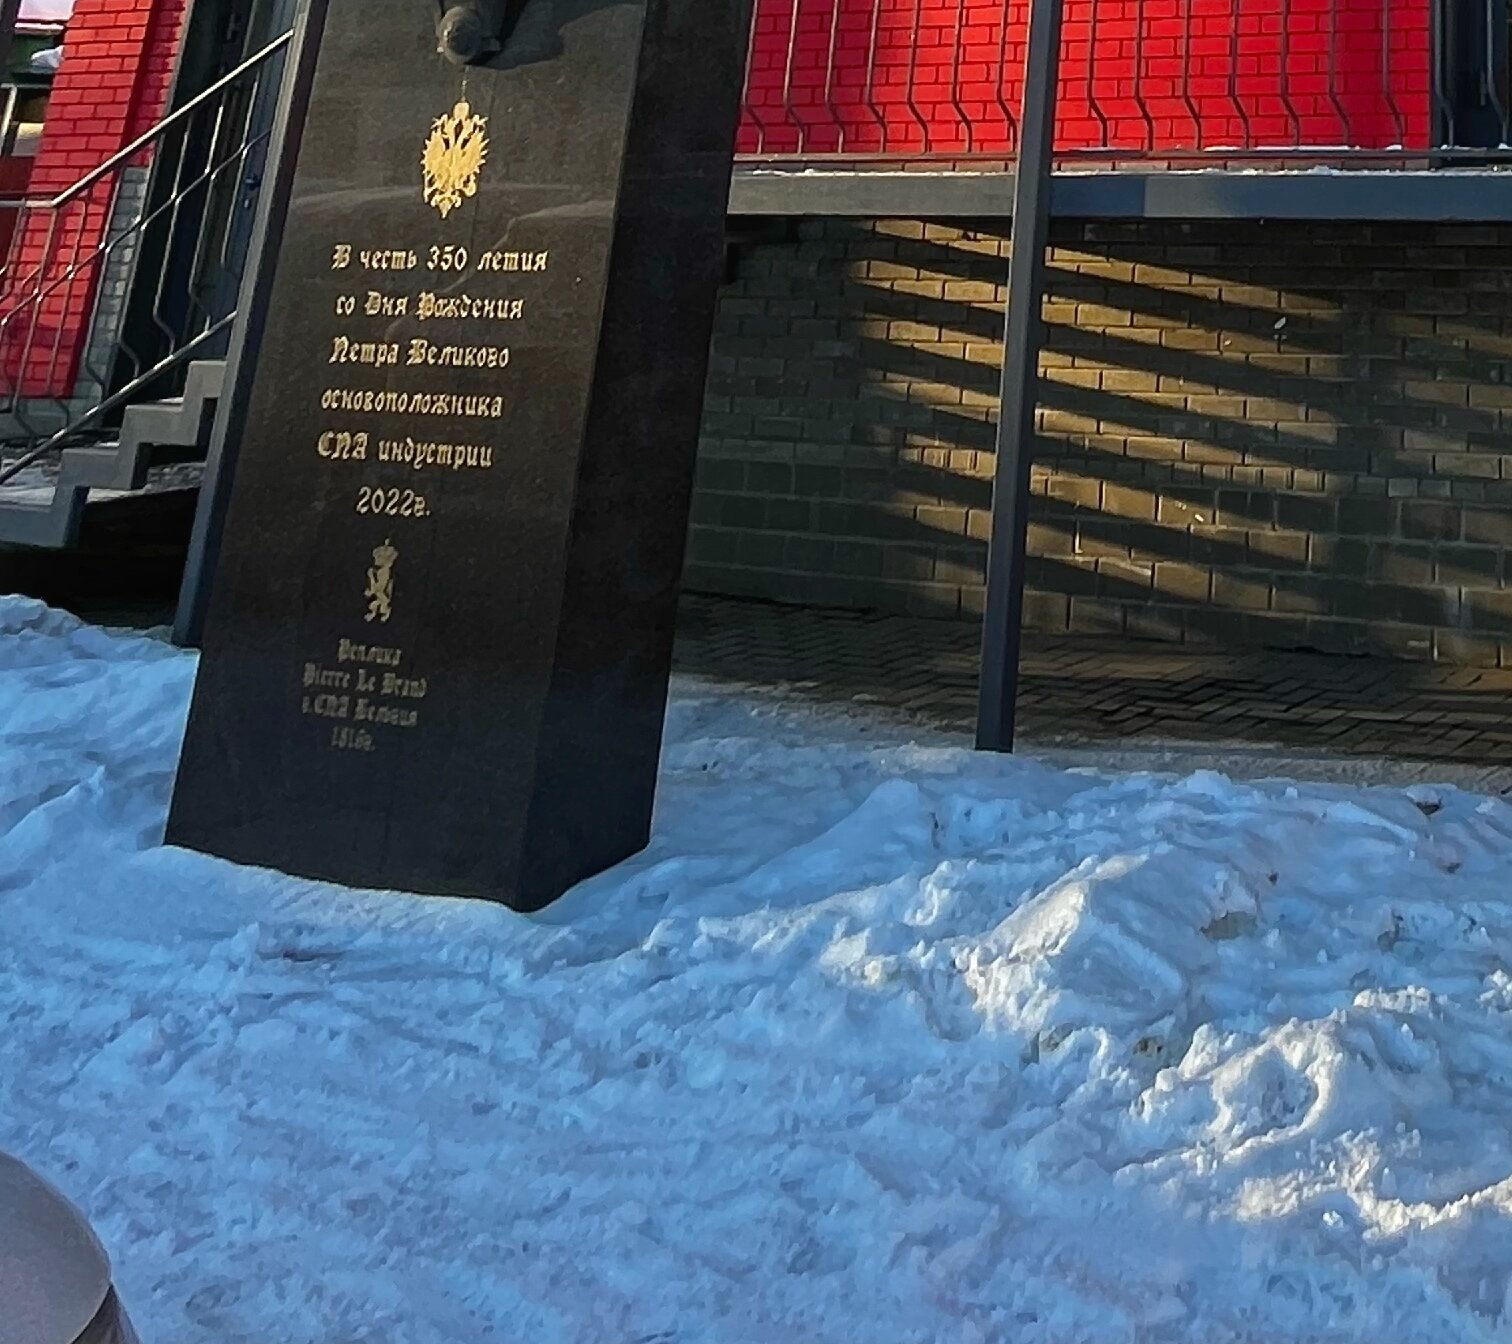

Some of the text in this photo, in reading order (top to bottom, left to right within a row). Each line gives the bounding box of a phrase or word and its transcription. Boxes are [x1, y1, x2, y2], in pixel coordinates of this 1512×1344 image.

[331, 244, 549, 272] В честь 350 летия
[336, 289, 524, 320] со Дня Рождения
[329, 335, 510, 368] Петра Великого
[321, 388, 504, 417] основоположника
[318, 430, 493, 470] СПА индустрии
[356, 486, 431, 517] 2022г.
